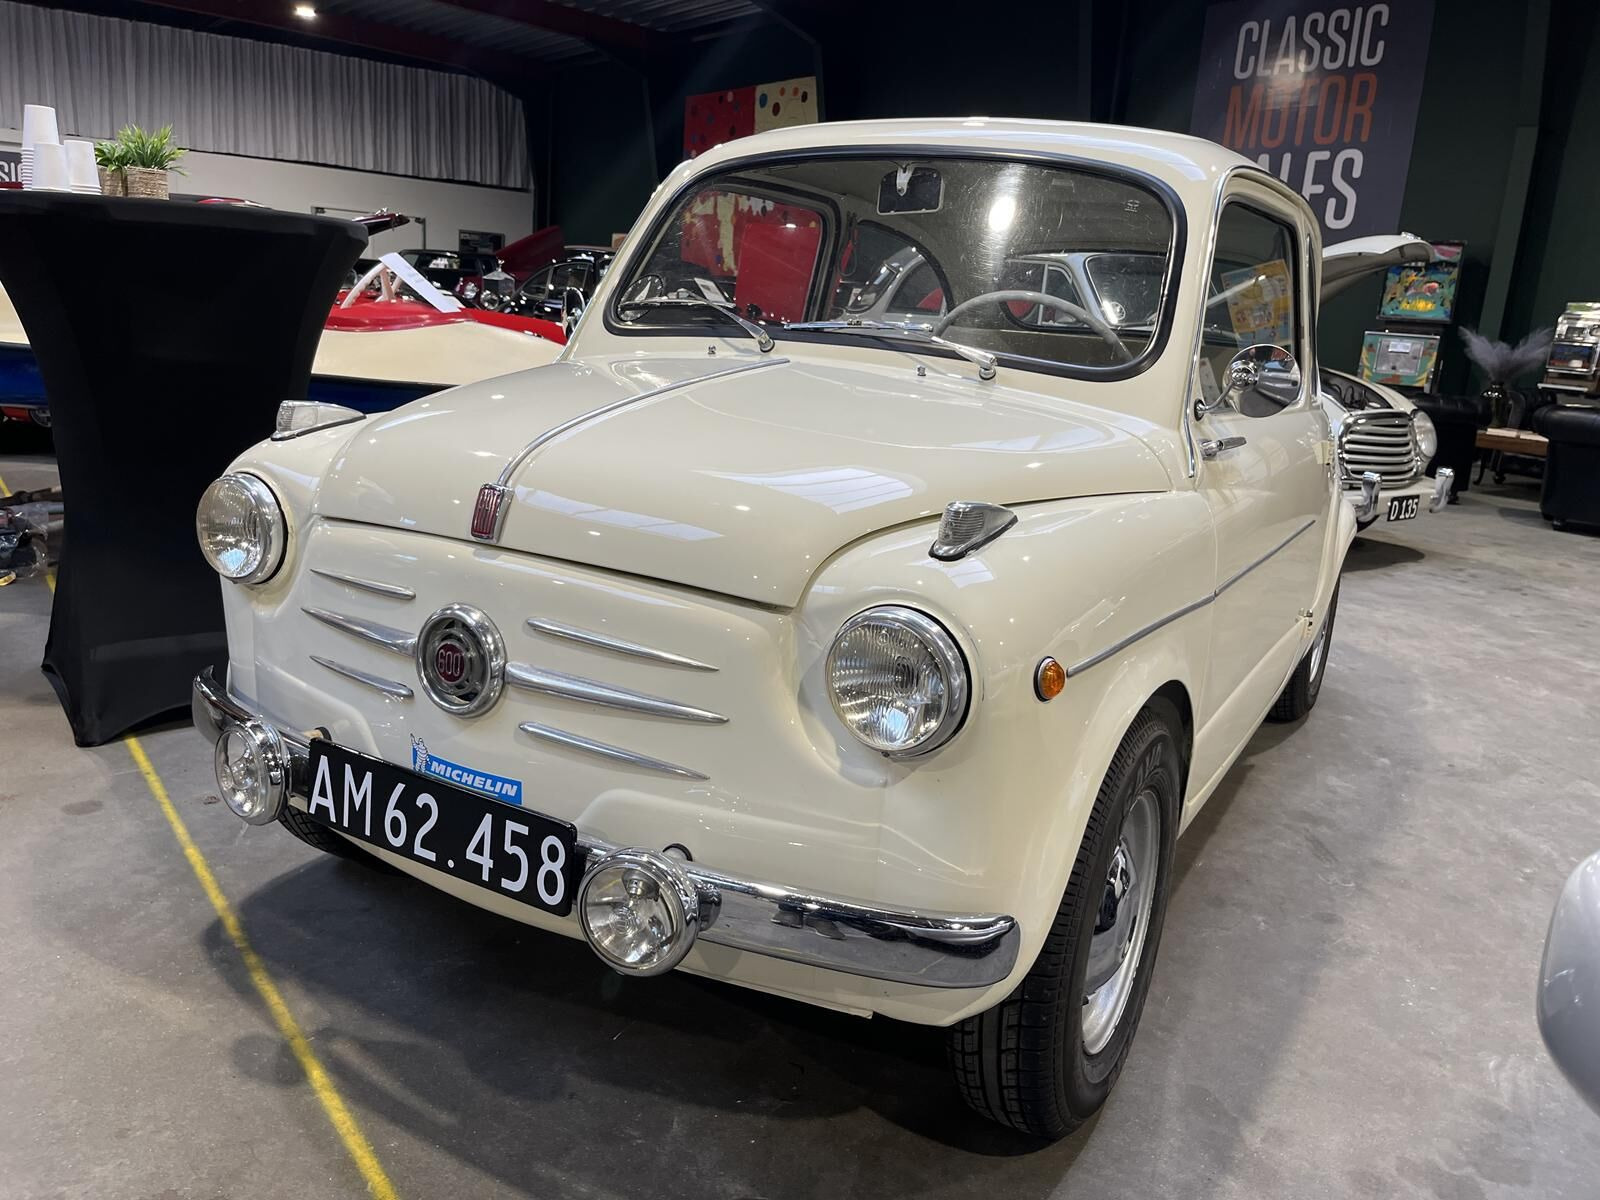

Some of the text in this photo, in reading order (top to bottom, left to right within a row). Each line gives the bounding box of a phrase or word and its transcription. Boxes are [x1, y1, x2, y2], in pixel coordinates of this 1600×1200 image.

[1234, 4, 1389, 79] CLASSIC
[1223, 73, 1377, 149] MOTOR
[1390, 499, 1418, 520] D 135
[438, 649, 461, 677] 600
[431, 761, 518, 797] MICHELIN
